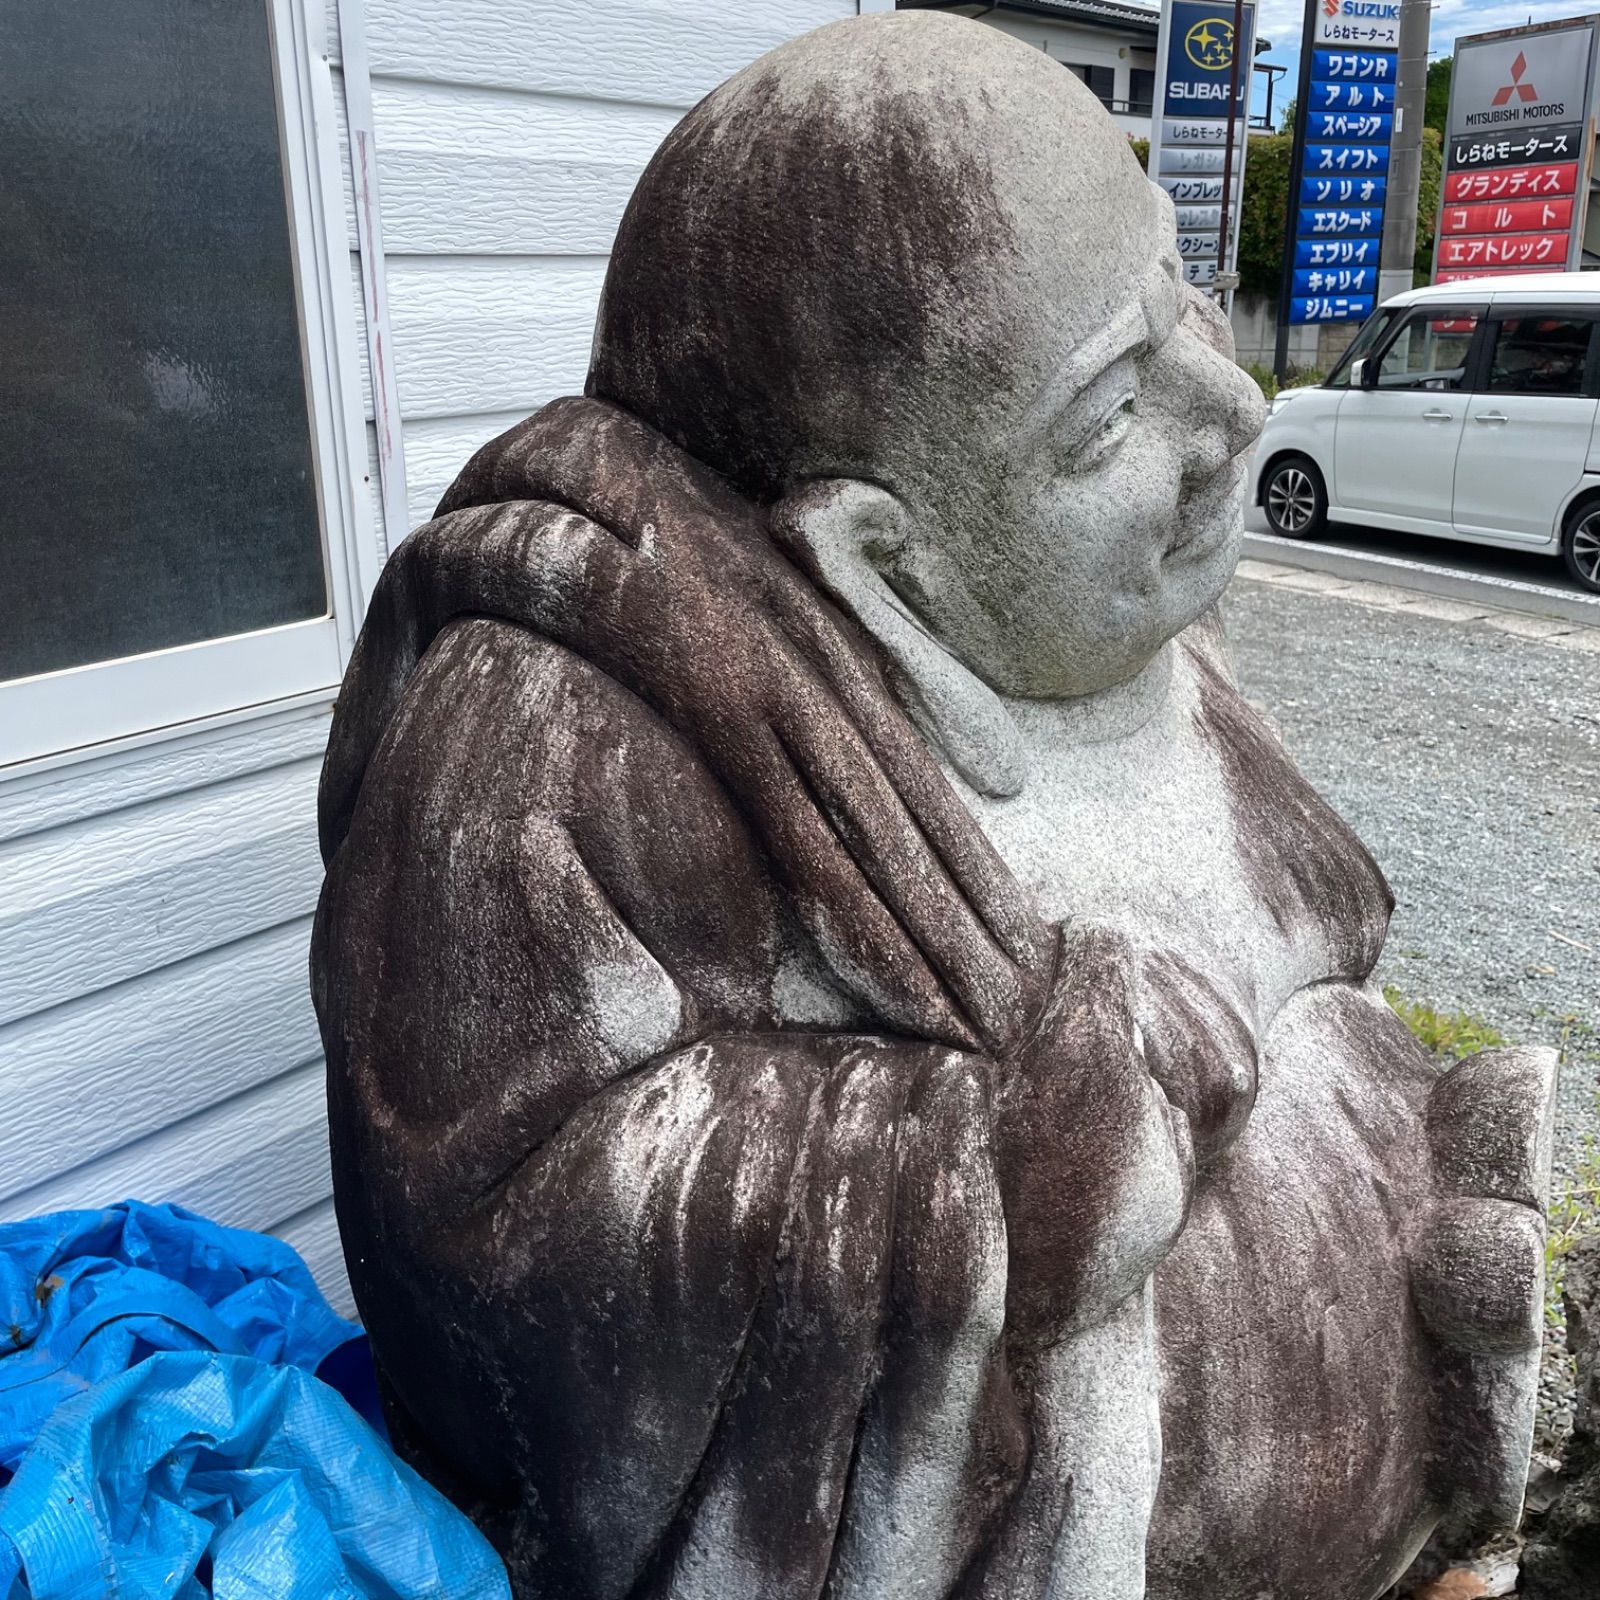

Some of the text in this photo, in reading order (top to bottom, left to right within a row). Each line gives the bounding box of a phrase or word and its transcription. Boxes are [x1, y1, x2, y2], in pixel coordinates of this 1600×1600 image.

[1343, 1, 1400, 20] SUZUK
[1324, 24, 1395, 42] しらねモータース
[1328, 55, 1388, 77] ワゴンR
[1325, 85, 1384, 107] アルト
[1466, 103, 1564, 126] MITSUBISHI MOTORS
[1173, 126, 1228, 139] しらねモーター
[1322, 115, 1381, 136] スペーシア
[1319, 148, 1379, 169] スイフト
[1456, 135, 1568, 164] しらねモータース
[1181, 152, 1221, 169] レガシ
[1169, 182, 1222, 199] インプレッ
[1317, 180, 1375, 201] ソリオ
[1457, 170, 1560, 198] グランディス
[1312, 211, 1372, 232] エスクード
[1452, 204, 1556, 229] コルト
[1177, 238, 1219, 253] クシー
[1449, 238, 1553, 262] エアトレック
[1189, 265, 1217, 280] テラ
[1305, 299, 1363, 320] ジムニー
